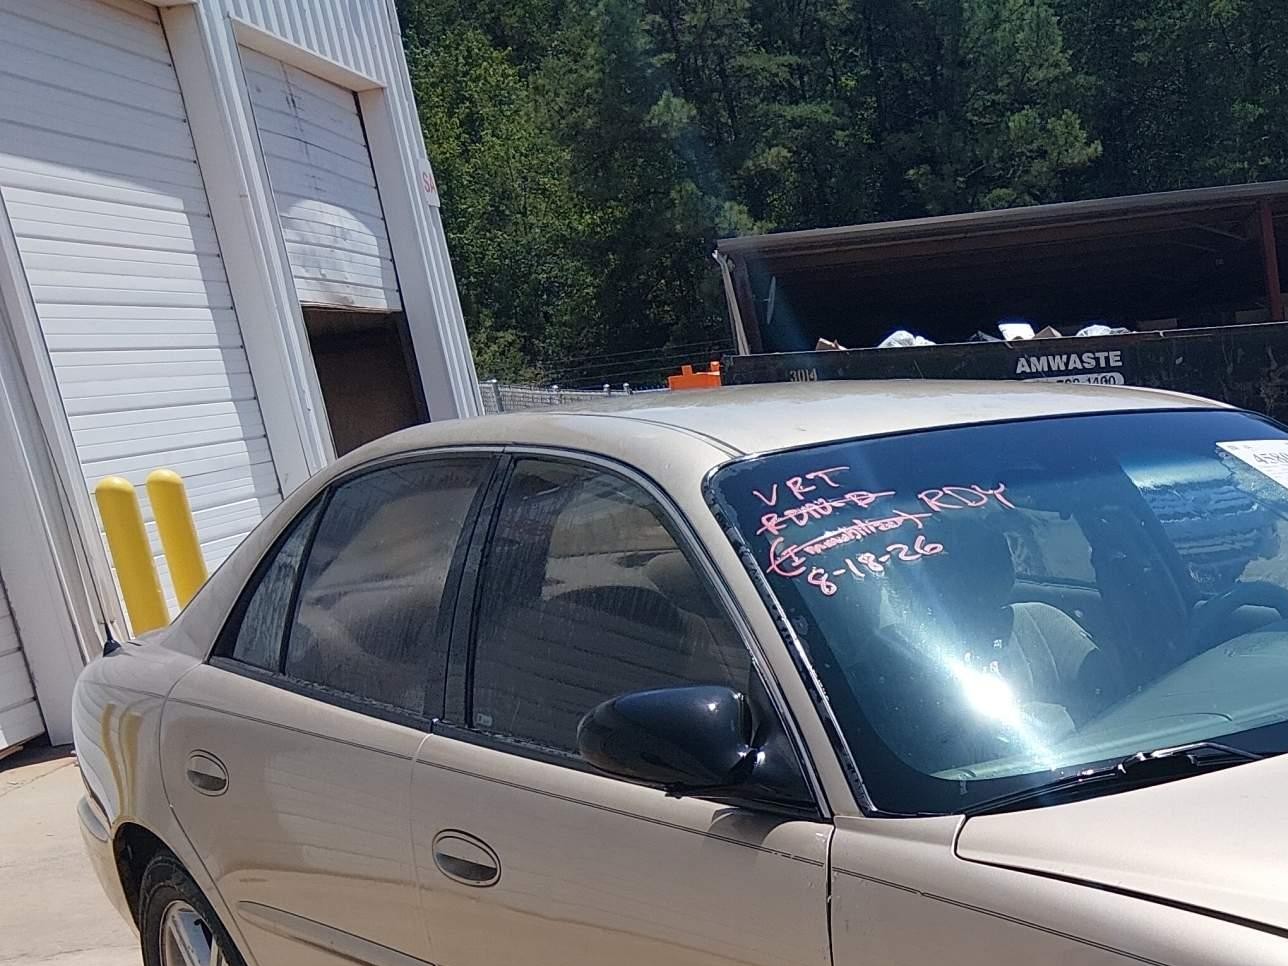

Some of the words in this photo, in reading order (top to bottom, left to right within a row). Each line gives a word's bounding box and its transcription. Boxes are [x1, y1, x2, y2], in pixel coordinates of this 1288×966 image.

[1016, 351, 1123, 374] AMWASTE
[752, 466, 850, 506] VRT
[807, 535, 944, 596] 8-18-26
